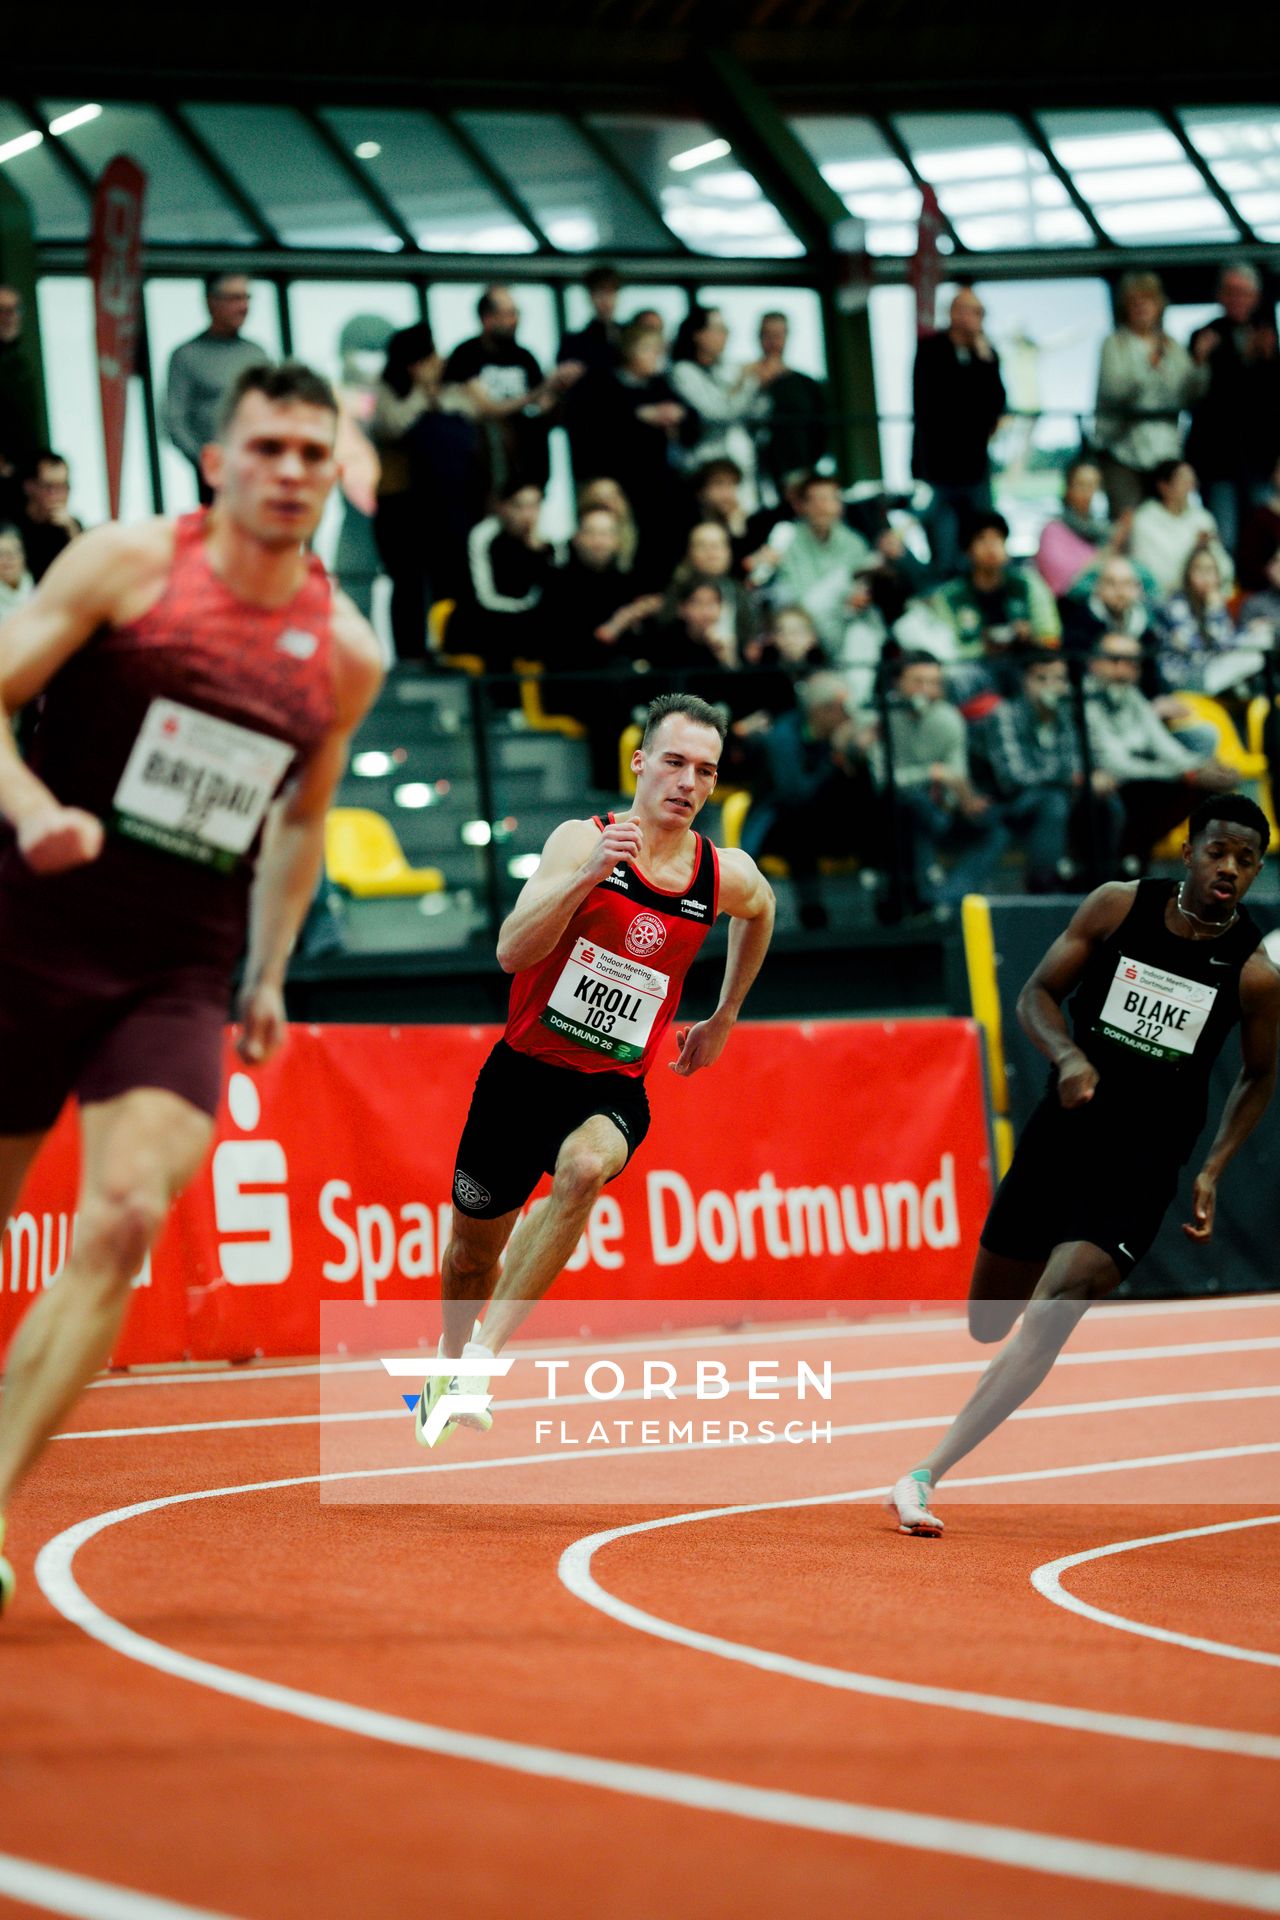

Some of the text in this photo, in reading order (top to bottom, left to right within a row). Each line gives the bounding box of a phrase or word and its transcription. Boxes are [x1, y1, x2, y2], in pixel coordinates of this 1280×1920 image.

[595, 962, 631, 981] Dortmund
[600, 953, 652, 980] Indoor Meeting
[573, 975, 642, 1022] KROLL
[1123, 991, 1191, 1031] BLAKE
[550, 1015, 613, 1050] DORTMUND 26
[584, 1007, 616, 1034] 103
[1133, 1019, 1163, 1042] 212
[1103, 1026, 1151, 1053] DORTMUND
[646, 1152, 961, 1266] Dortmund
